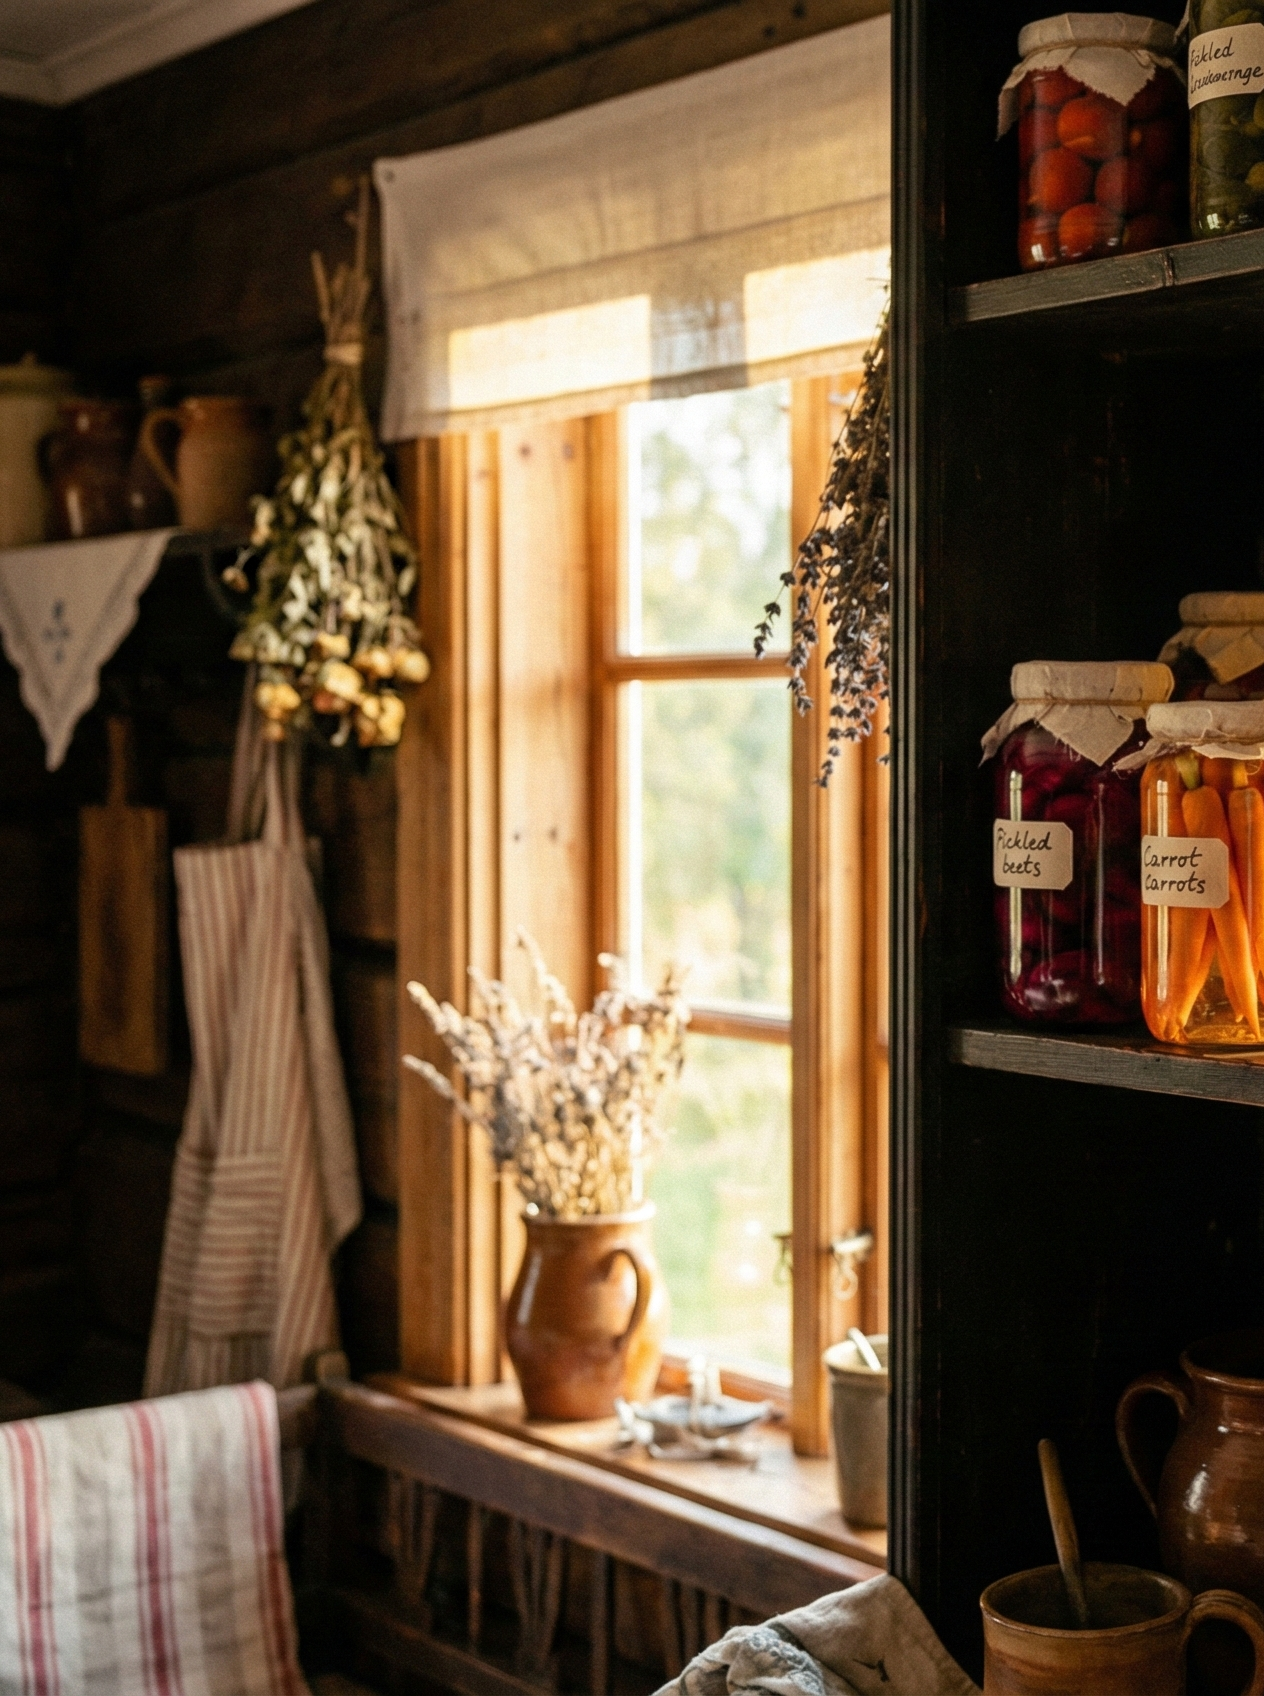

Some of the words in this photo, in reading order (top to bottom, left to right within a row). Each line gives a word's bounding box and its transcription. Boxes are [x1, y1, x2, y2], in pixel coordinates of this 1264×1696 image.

[996, 827, 1052, 850] Pickled
[1002, 853, 1042, 877] beets
[1144, 845, 1203, 868] Carrot
